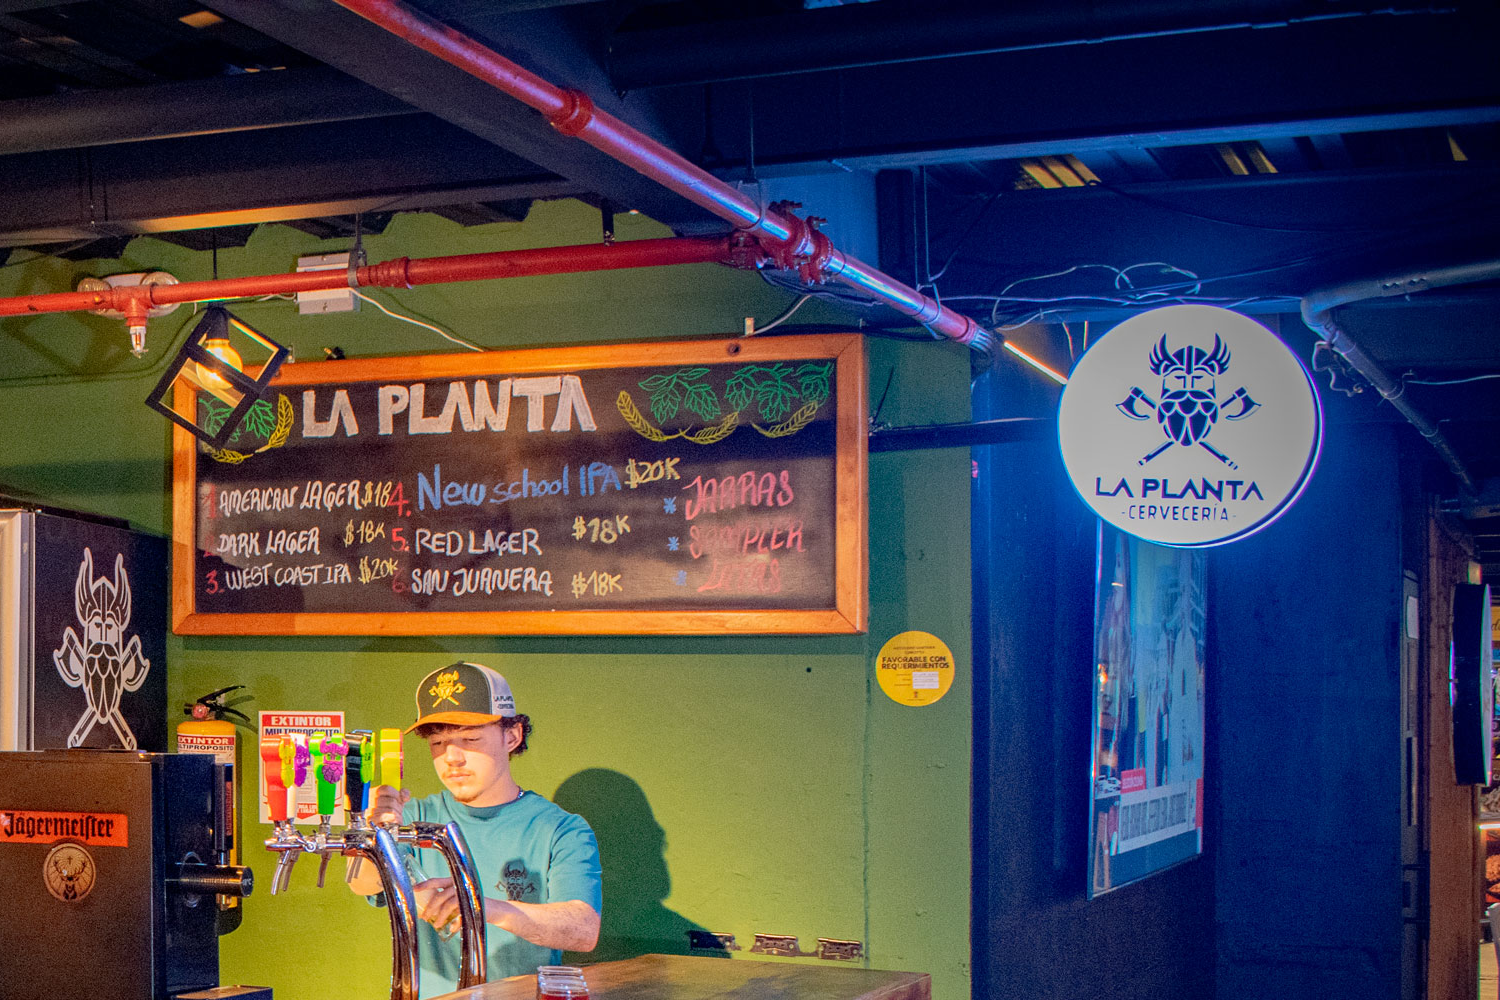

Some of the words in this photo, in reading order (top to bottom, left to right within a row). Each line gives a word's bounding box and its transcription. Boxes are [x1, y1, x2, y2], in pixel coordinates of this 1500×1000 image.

[302, 388, 359, 438] LA
[377, 374, 598, 435] PLANTA
[219, 486, 299, 518] AMERICAN
[299, 480, 363, 512] LAGER
[417, 463, 486, 511] New
[489, 464, 569, 503] school
[579, 461, 622, 496] IPA
[624, 457, 681, 489] $20K
[682, 470, 794, 520] JARRAS
[1095, 477, 1134, 498] LA
[1141, 477, 1264, 502] PLANTA
[217, 532, 260, 558] DARK
[265, 526, 320, 556] LAGER
[415, 528, 463, 556] RED
[468, 528, 543, 556] LAGER
[571, 515, 631, 544] $18K
[225, 562, 274, 591] WEST
[274, 563, 325, 588] COAST
[322, 563, 353, 585] IPA
[358, 555, 400, 585] $20K
[411, 567, 449, 595] SAN
[452, 567, 554, 597] JUANERA
[571, 570, 623, 599] $18K
[881, 656, 928, 664] FAVORABLE
[881, 662, 950, 670] REQUERIMIENTOS
[270, 715, 332, 726] EXTINTOR
[179, 744, 235, 752] LTIPROPOSITO
[3, 812, 114, 841] Jägermeister
